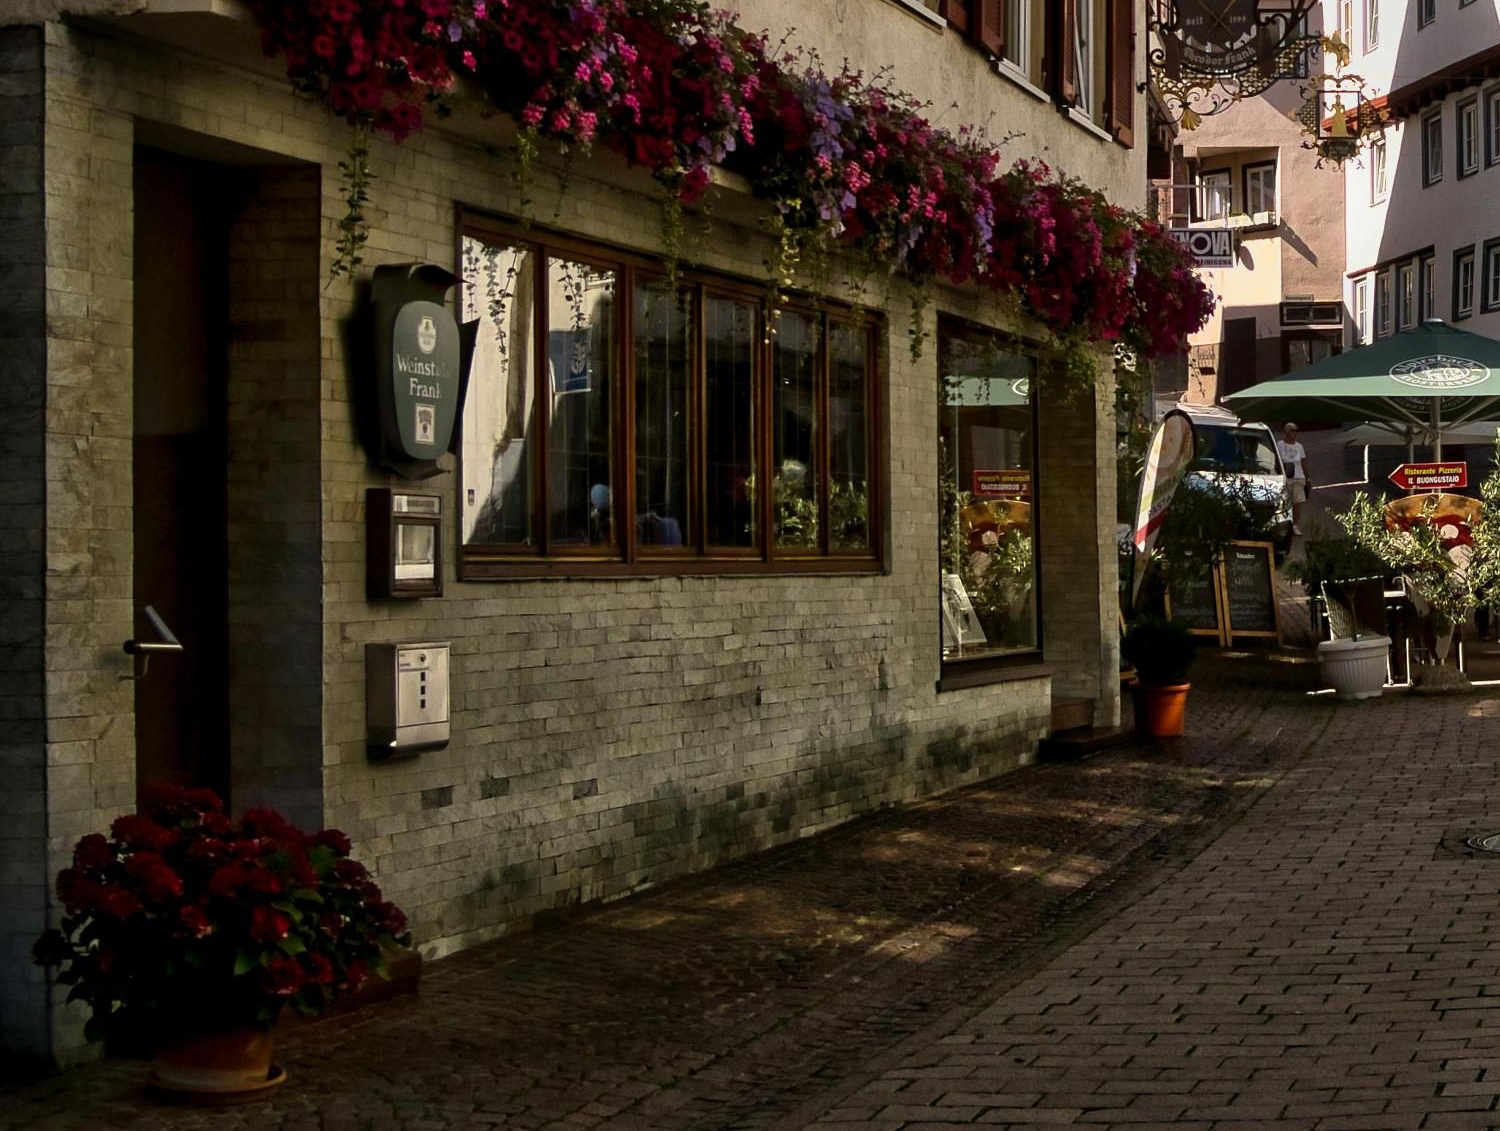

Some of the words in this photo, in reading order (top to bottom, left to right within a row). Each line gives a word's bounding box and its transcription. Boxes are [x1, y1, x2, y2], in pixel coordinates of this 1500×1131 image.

[396, 353, 452, 378] Weinstu
[409, 377, 442, 399] Frank
[1404, 468, 1436, 476] Ristorante
[1438, 466, 1462, 474] Pizzeria
[1416, 475, 1460, 484] BUONGUSTAIO
